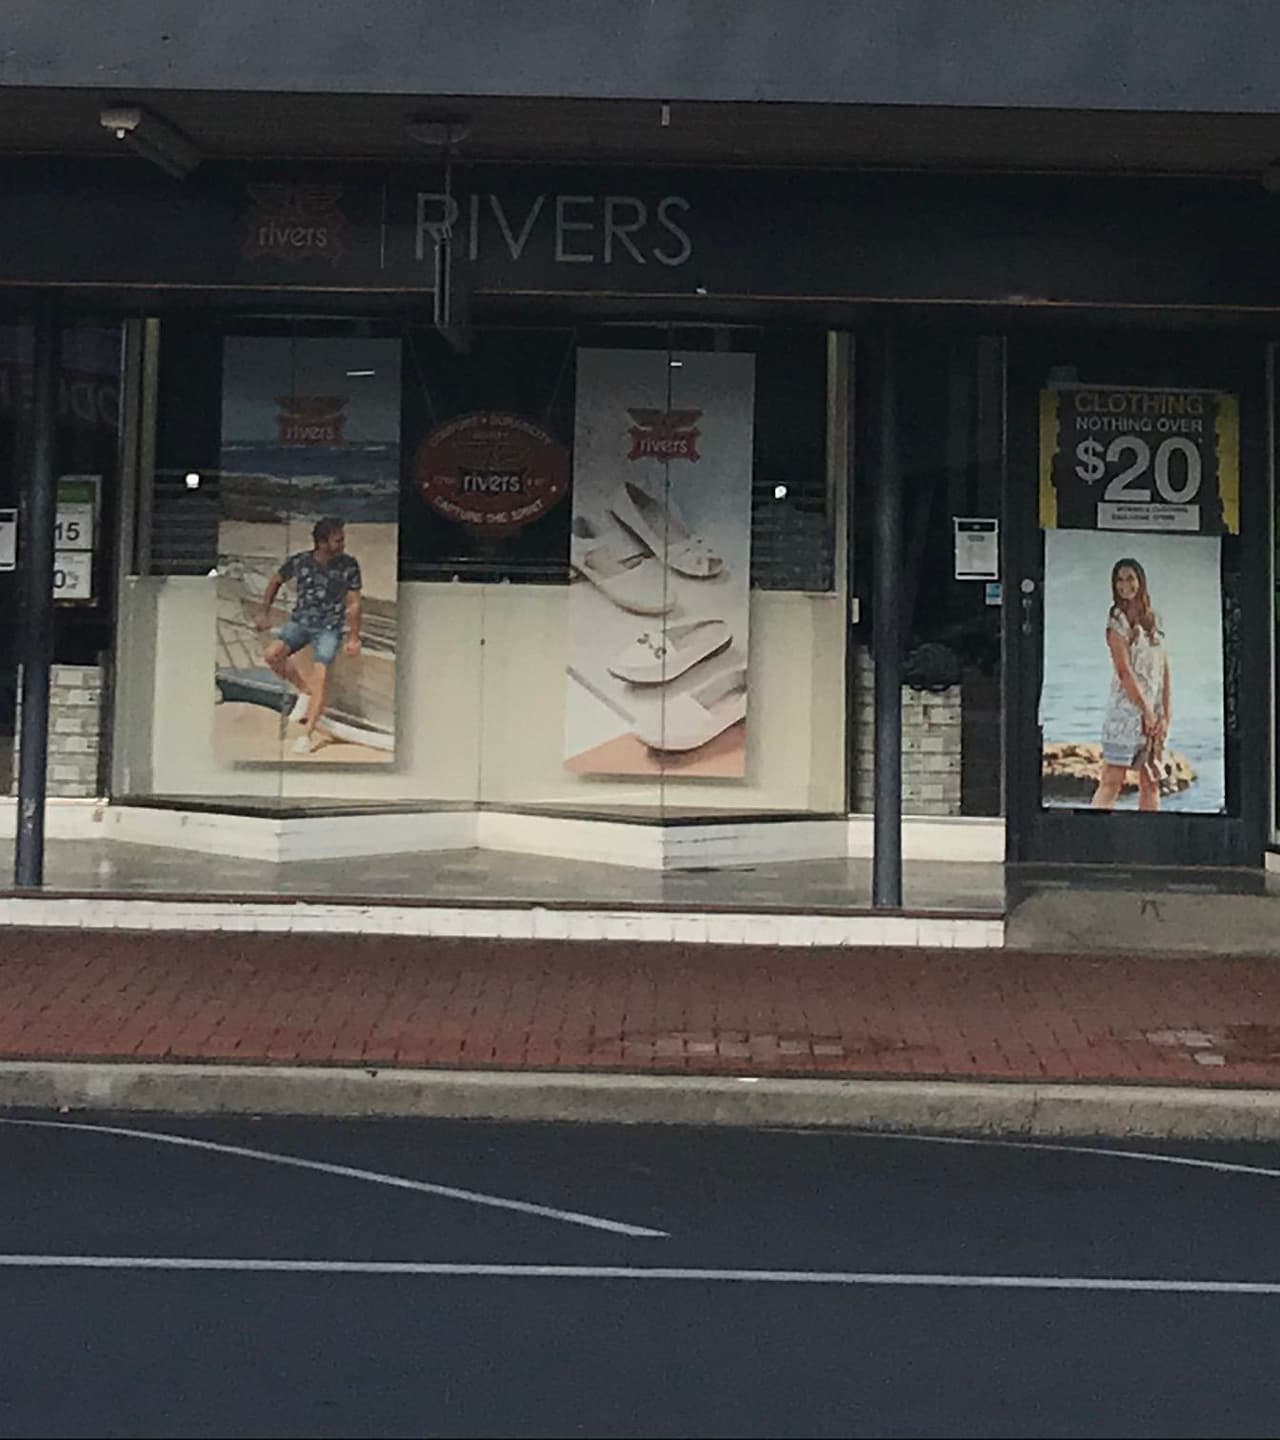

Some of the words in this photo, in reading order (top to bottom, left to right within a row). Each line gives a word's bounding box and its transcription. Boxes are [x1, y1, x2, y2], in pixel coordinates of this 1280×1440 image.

[258, 221, 328, 248] rivers
[414, 191, 694, 267] RIVERS
[1074, 392, 1204, 414] CLOTHING
[286, 424, 336, 440] rivers
[1075, 416, 1152, 432] NOTHING
[1156, 417, 1203, 433] OVER
[639, 438, 689, 454] rivers
[1074, 434, 1203, 504] $20
[463, 473, 521, 493] rivers
